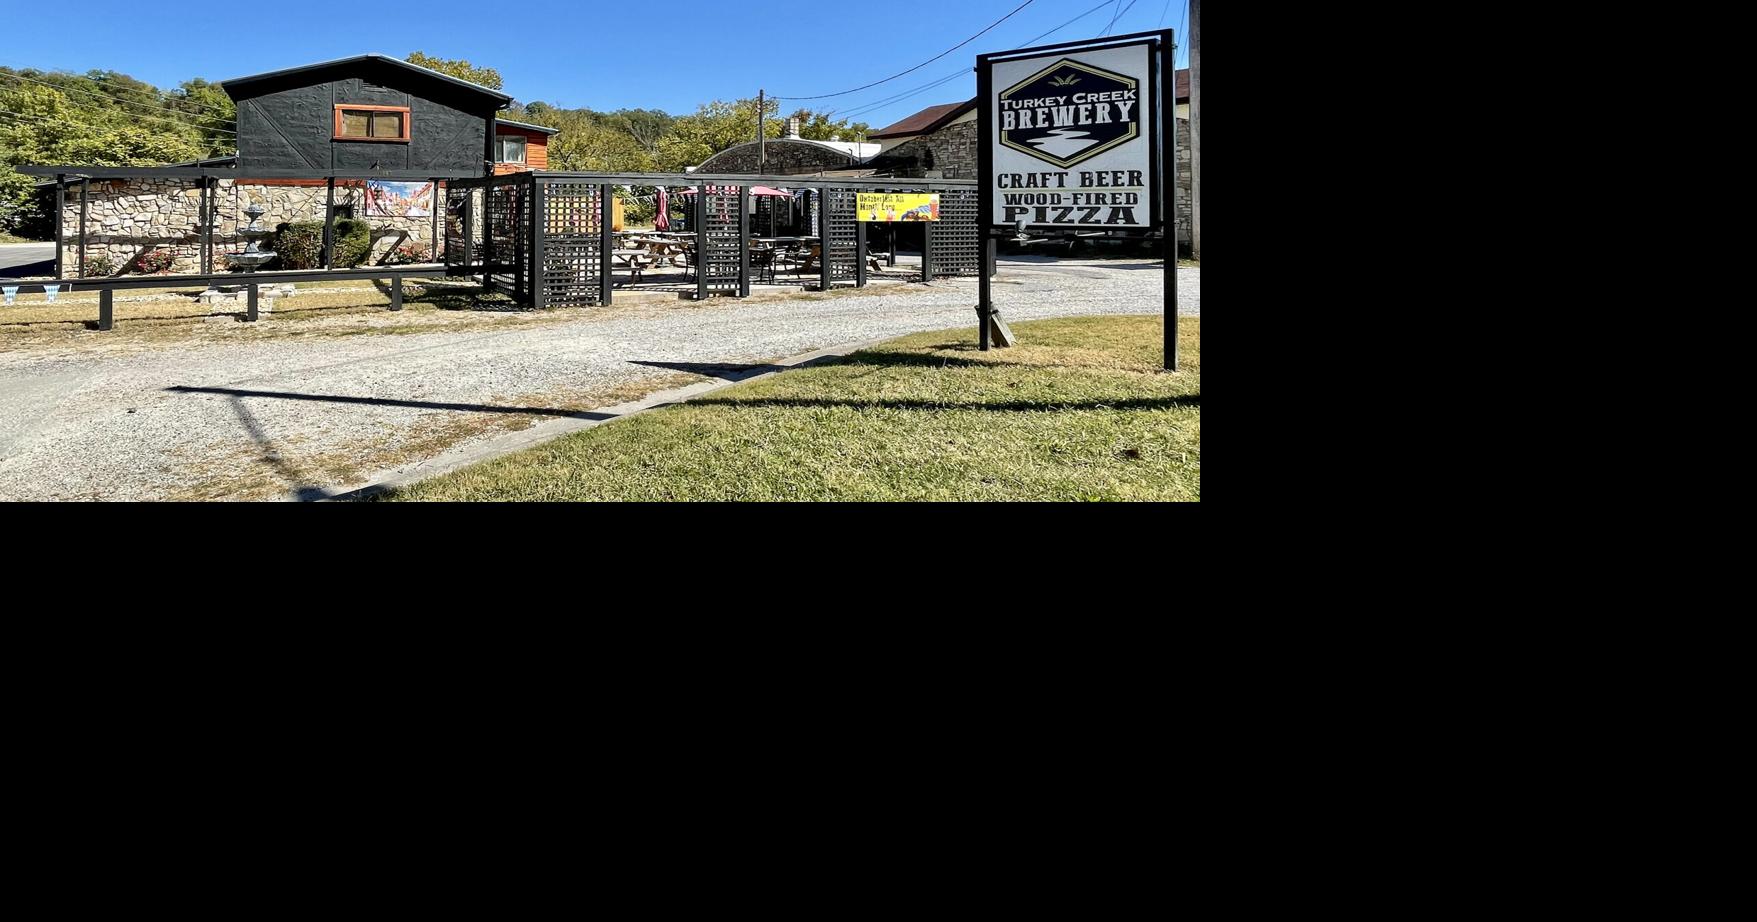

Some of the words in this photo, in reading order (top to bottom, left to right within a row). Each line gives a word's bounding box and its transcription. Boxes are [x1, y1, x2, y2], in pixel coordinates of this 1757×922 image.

[1001, 96, 1066, 109] TURKEY
[1073, 90, 1136, 103] CREEK
[1003, 101, 1135, 130] BREWERY
[997, 172, 1069, 189] CRAFT
[1079, 170, 1144, 188] BEER
[1003, 192, 1139, 206] WOOD-FIRED
[1002, 206, 1139, 225] PIZZA
